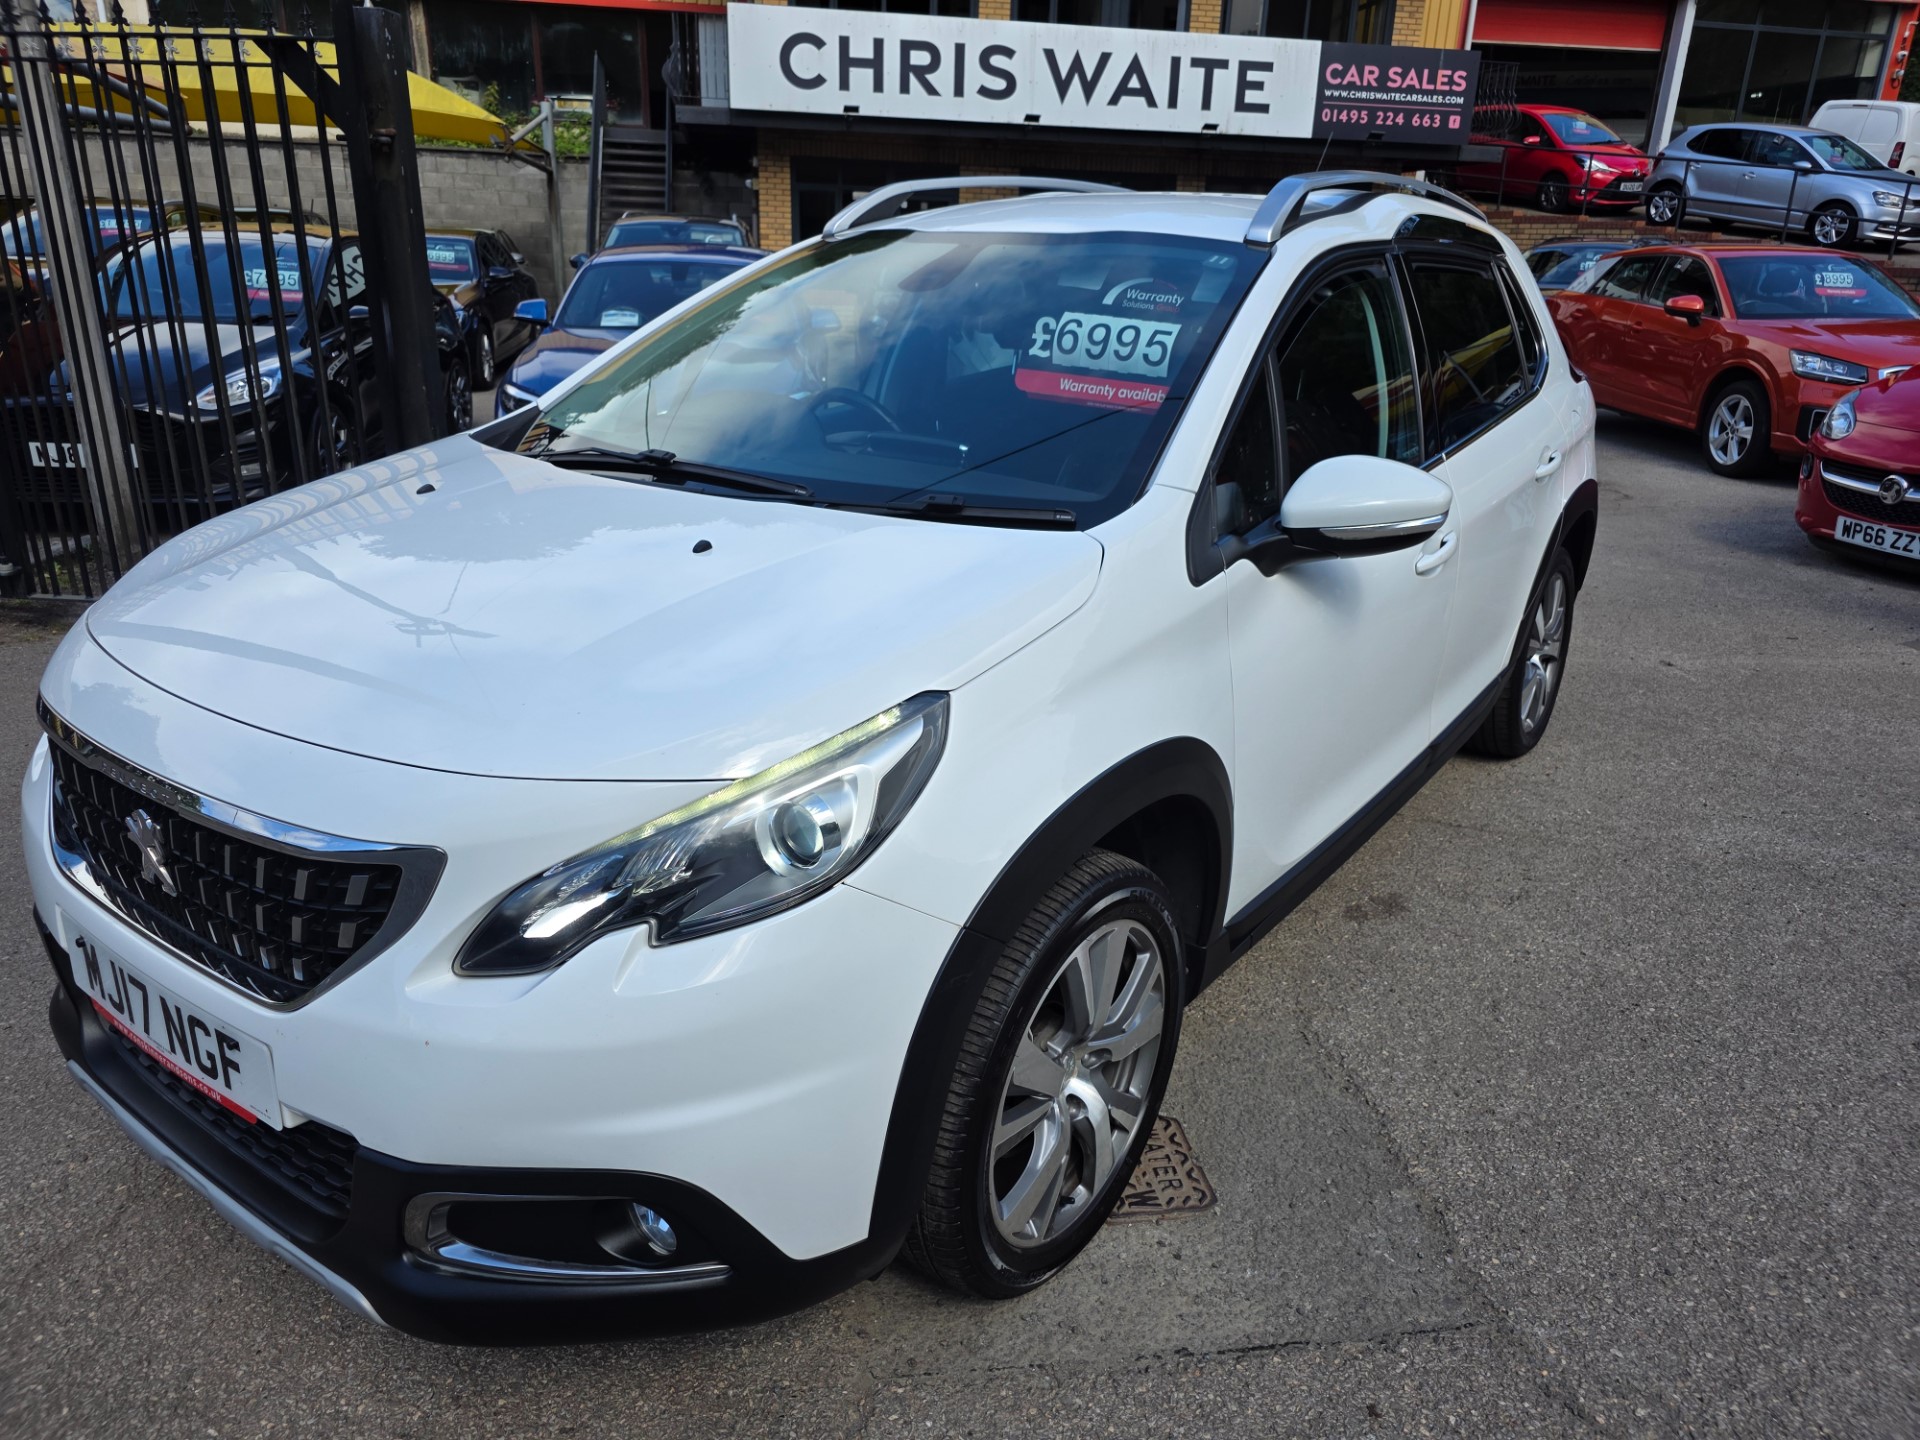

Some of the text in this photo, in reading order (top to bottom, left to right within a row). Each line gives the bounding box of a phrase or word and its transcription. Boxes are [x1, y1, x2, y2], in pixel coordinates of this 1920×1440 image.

[779, 32, 1274, 114] CHRIS WAITE
[1325, 63, 1467, 92] CAR SALES
[1324, 89, 1464, 105] WWW.CHRISWAITECARSALES.COM
[1321, 108, 1369, 124] 01495
[1375, 111, 1405, 126] 224
[1411, 113, 1441, 128] 663
[244, 269, 298, 287] £795
[1815, 273, 1853, 286] £8995
[1122, 299, 1154, 311] Solutions
[1126, 288, 1184, 306] Warranty
[1029, 316, 1173, 367] £6995
[1060, 378, 1116, 401] Warranty
[1841, 519, 1920, 555] WP66 ZZ
[82, 943, 241, 1090] MJ17 NGF
